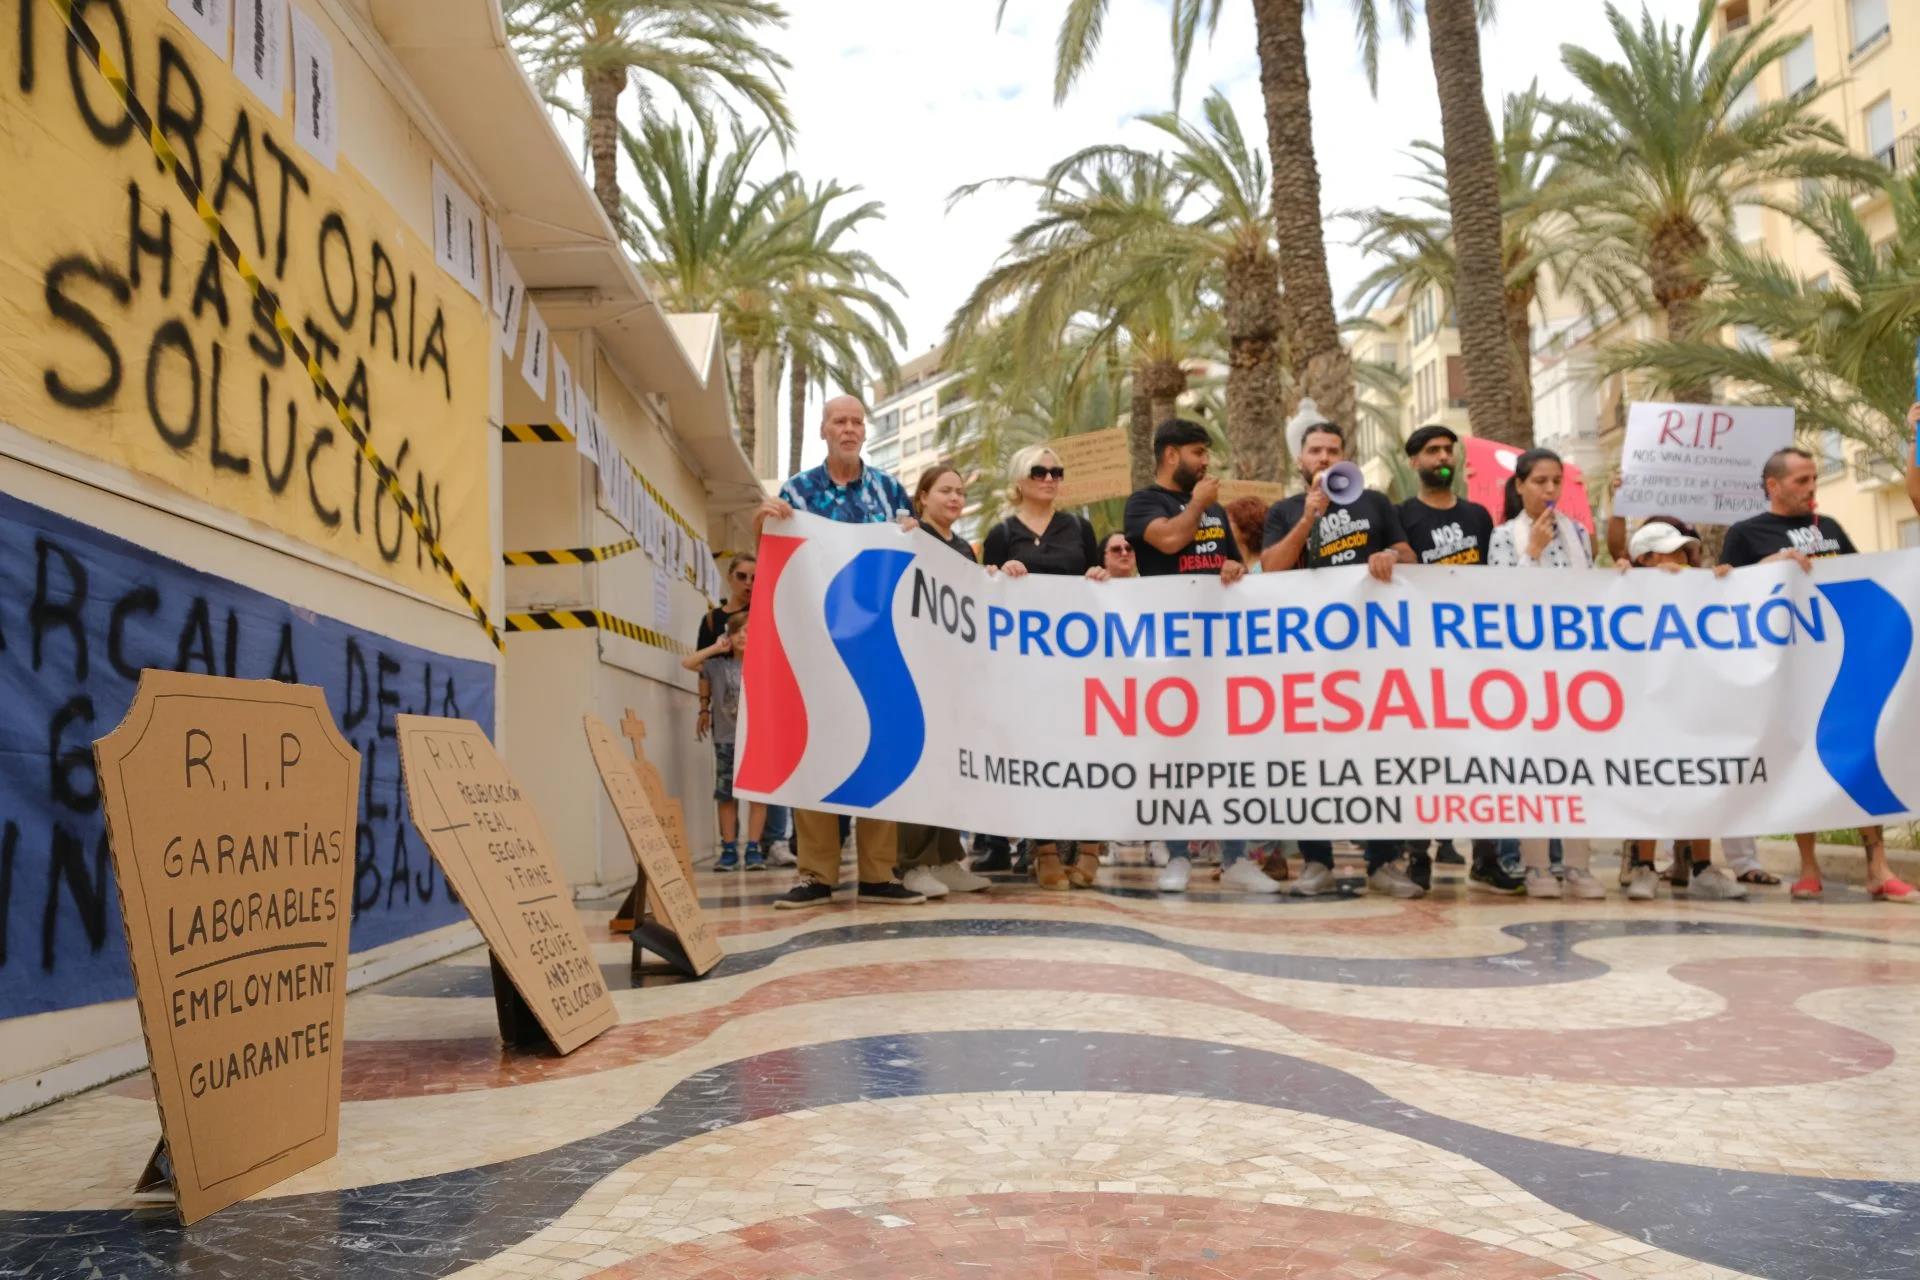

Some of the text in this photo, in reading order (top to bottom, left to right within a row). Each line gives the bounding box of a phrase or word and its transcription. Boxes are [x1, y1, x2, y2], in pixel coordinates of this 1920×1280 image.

[18, 0, 452, 404] ORATORIA
[127, 178, 373, 434] HASTA
[44, 254, 441, 570] SOLUCIÓN
[1195, 540, 1218, 554] NO
[1331, 549, 1356, 566] NO
[1431, 521, 1464, 549] NOS
[911, 567, 1826, 658] NOS PROMETIERON REUBICACIÓN
[1083, 667, 1626, 738] NO DESALOJO
[184, 728, 302, 792] R.I.P
[958, 747, 1768, 790] EL MERCADO HIPPIE DE LA EXPLANADA NECESITA
[1136, 794, 1586, 826] UNA SOLUCION URGENTE
[164, 820, 343, 879] GARANTÍAS
[487, 838, 537, 864] SEGURA
[168, 887, 337, 956] LABORABLES
[529, 931, 578, 965] SECURE
[172, 961, 335, 1029] EMPLOYMENT
[189, 1020, 330, 1100] GUARANTEE
